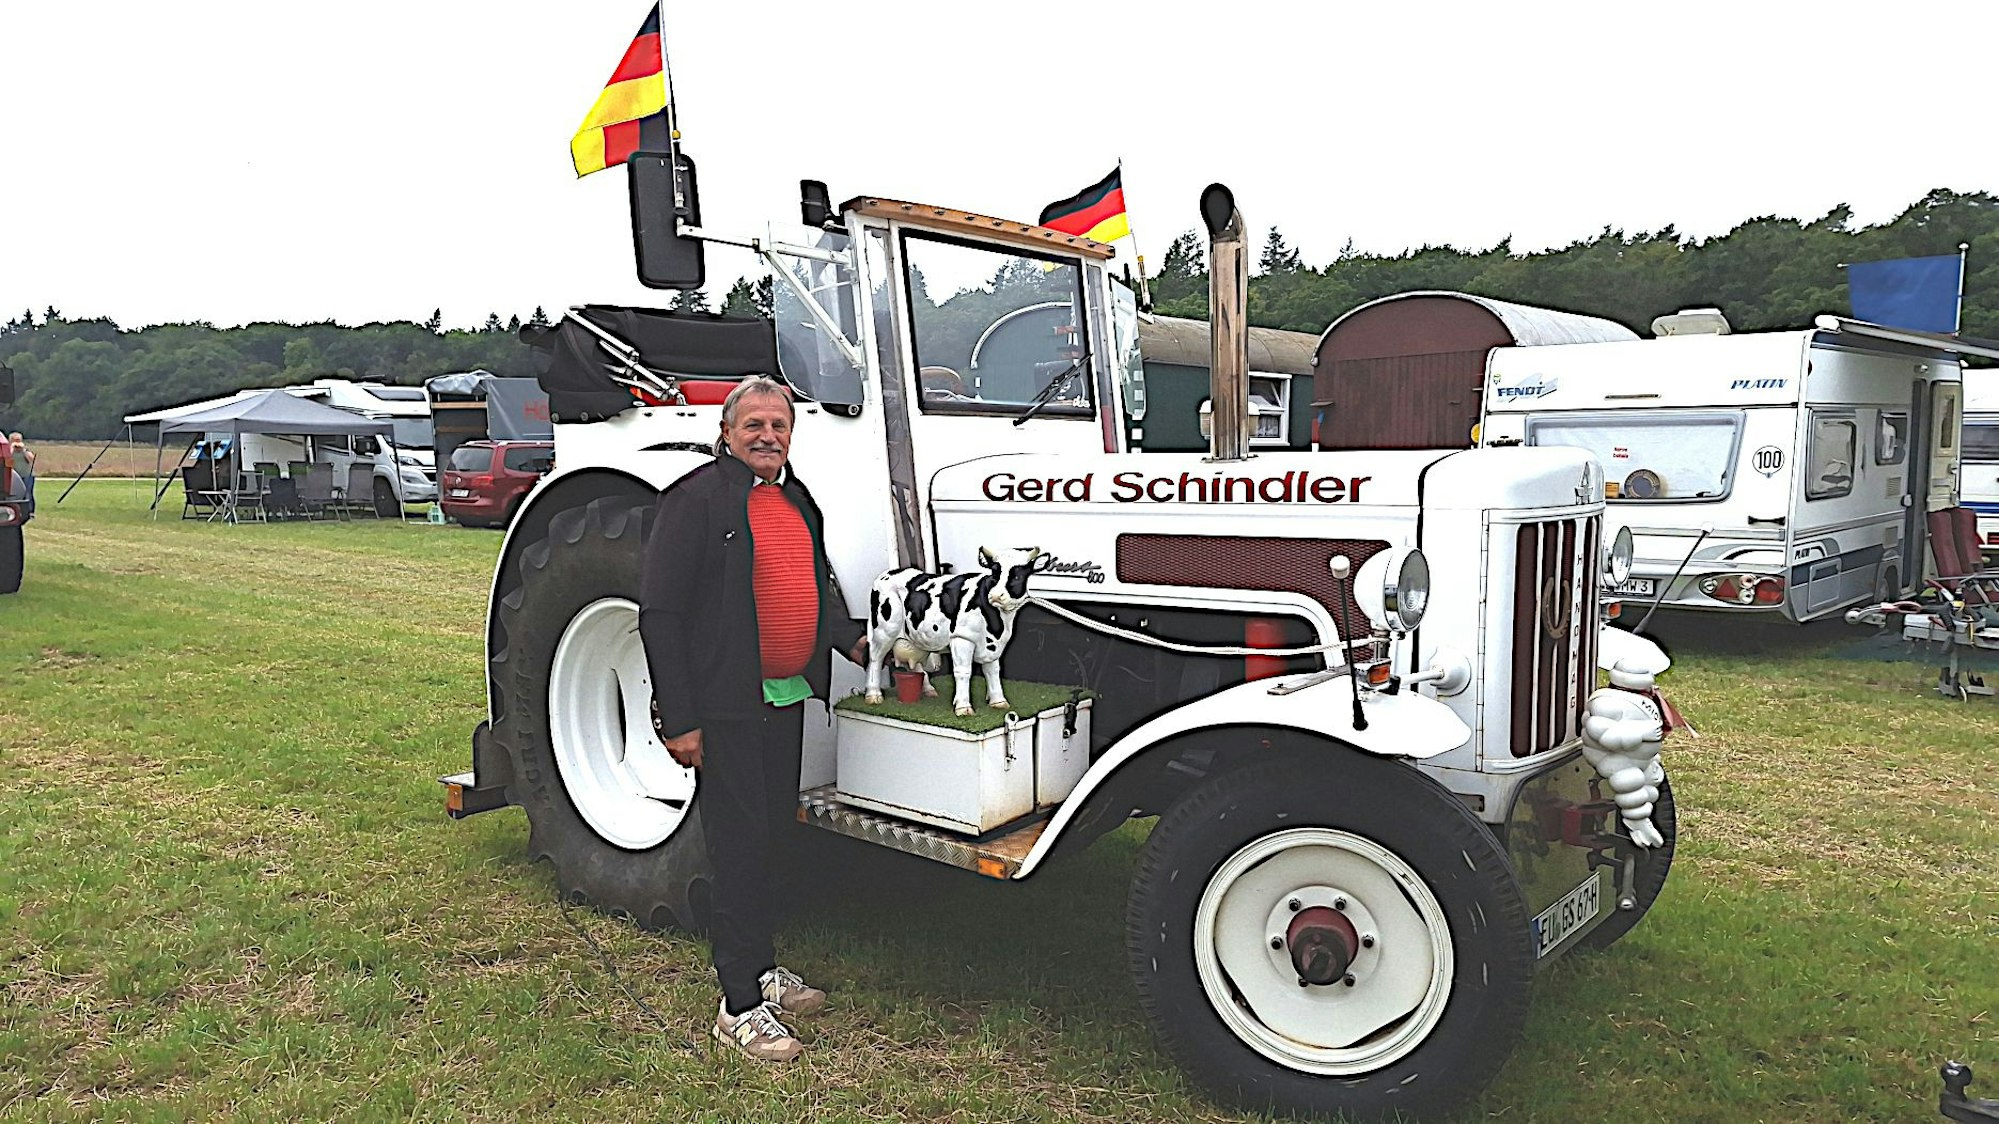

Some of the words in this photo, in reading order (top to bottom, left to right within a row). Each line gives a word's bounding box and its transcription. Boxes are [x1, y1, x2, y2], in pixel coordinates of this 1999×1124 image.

[1497, 386, 1545, 397] FENDT
[1730, 378, 1788, 390] PLATIN
[1757, 450, 1782, 469] 100
[982, 472, 1094, 502] Gerd
[1110, 471, 1373, 503] Schindler
[1640, 580, 1648, 592] 3
[1540, 912, 1556, 951] EU
[1562, 897, 1575, 934] GS
